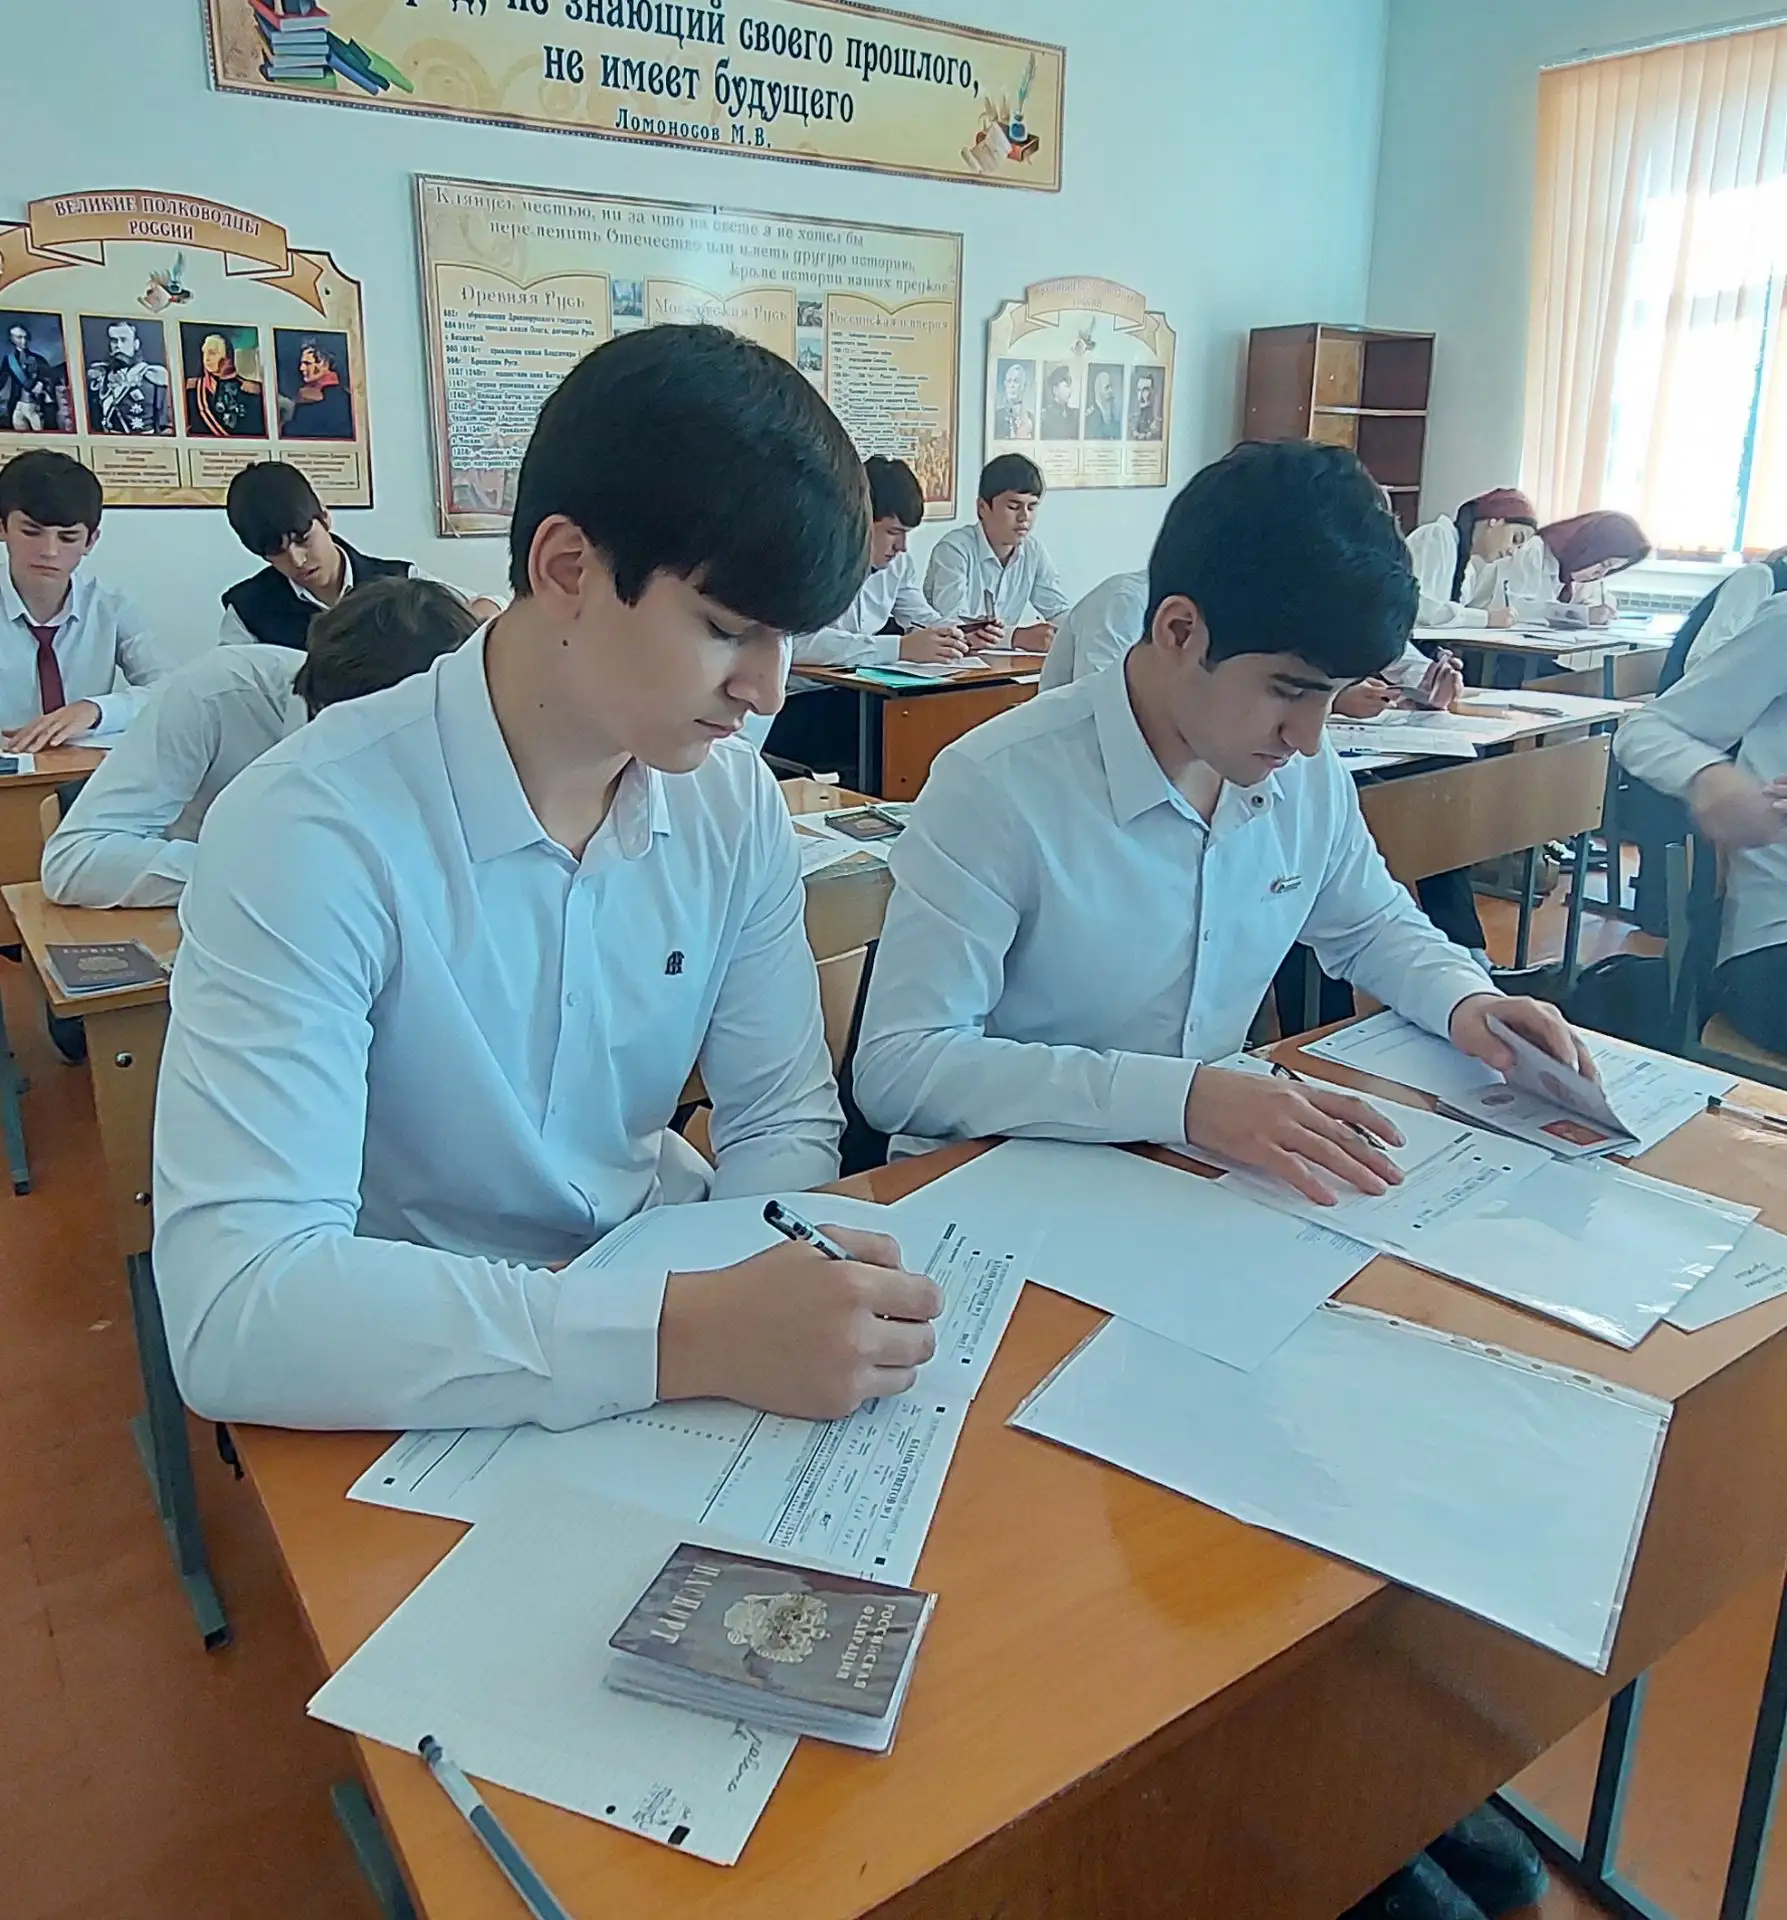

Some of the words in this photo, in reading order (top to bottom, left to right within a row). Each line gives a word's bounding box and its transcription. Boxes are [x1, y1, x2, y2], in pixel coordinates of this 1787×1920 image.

[565, 0, 725, 49] знающий
[739, 17, 833, 64] своего
[845, 36, 980, 98] прошлого,
[542, 45, 585, 84] не
[600, 53, 700, 101] имеет
[714, 55, 854, 128] будущего
[615, 108, 720, 141] Ломоносов
[55, 195, 137, 218] ВЕЛИКИЕ
[142, 196, 261, 237] ПОЛКОВОДЦЫ
[129, 220, 194, 240] РОССИИ
[601, 206, 622, 222] ни
[628, 209, 646, 225] за
[651, 213, 685, 229] что
[777, 226, 793, 240] не
[845, 230, 864, 248] бы
[792, 249, 847, 273] другую
[460, 284, 538, 307] Древняя
[544, 290, 585, 312] Русь
[847, 275, 892, 292] наших
[650, 1563, 721, 1645] ПАСПОРТ
[835, 1605, 876, 1681] ФЕДЕРАЦИЯ
[853, 1602, 897, 1690] РОССИЙСКАЯ
